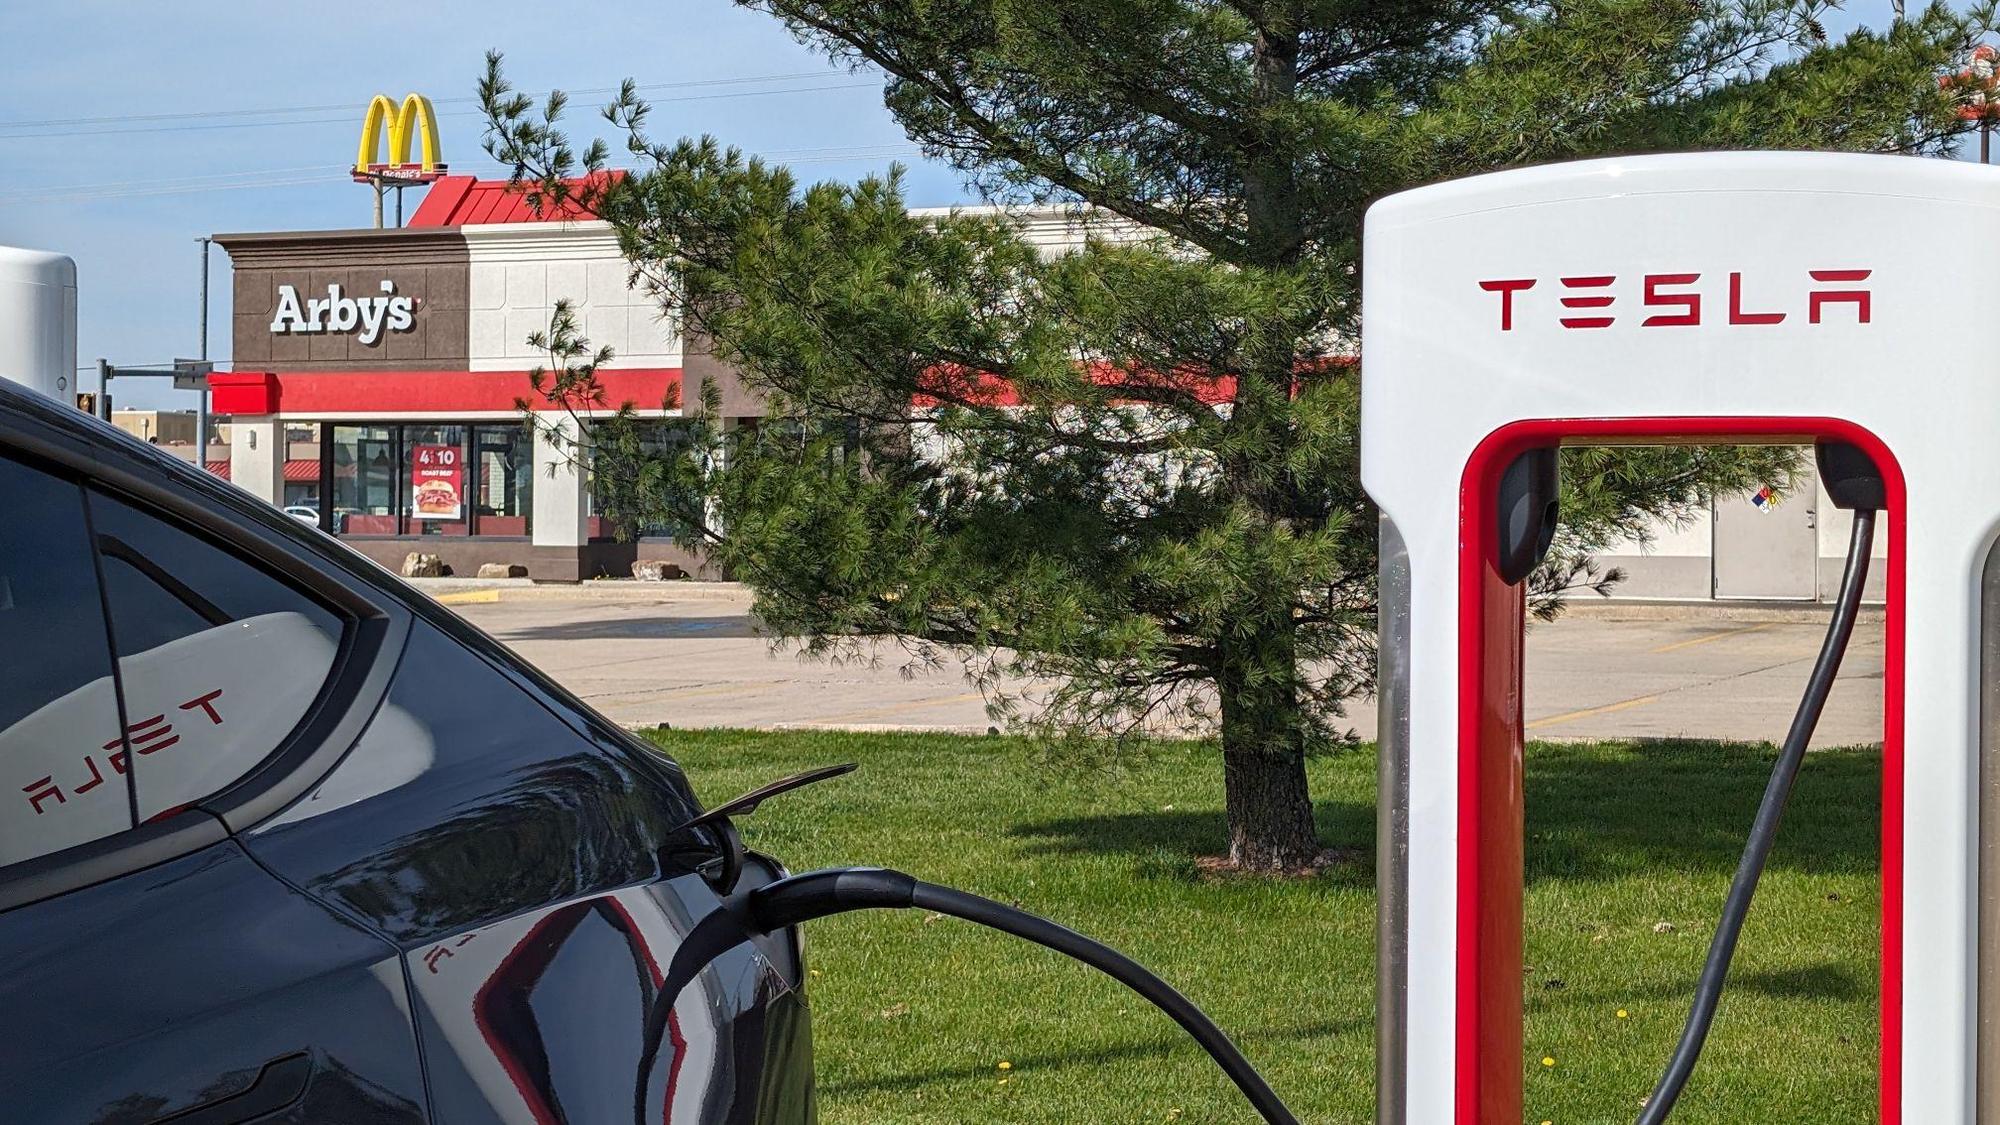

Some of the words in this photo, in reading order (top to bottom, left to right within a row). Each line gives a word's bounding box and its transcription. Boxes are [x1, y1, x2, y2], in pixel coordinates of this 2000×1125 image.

[270, 280, 412, 344] Arby's
[1479, 270, 1872, 331] TESLA
[420, 450, 430, 464] 4
